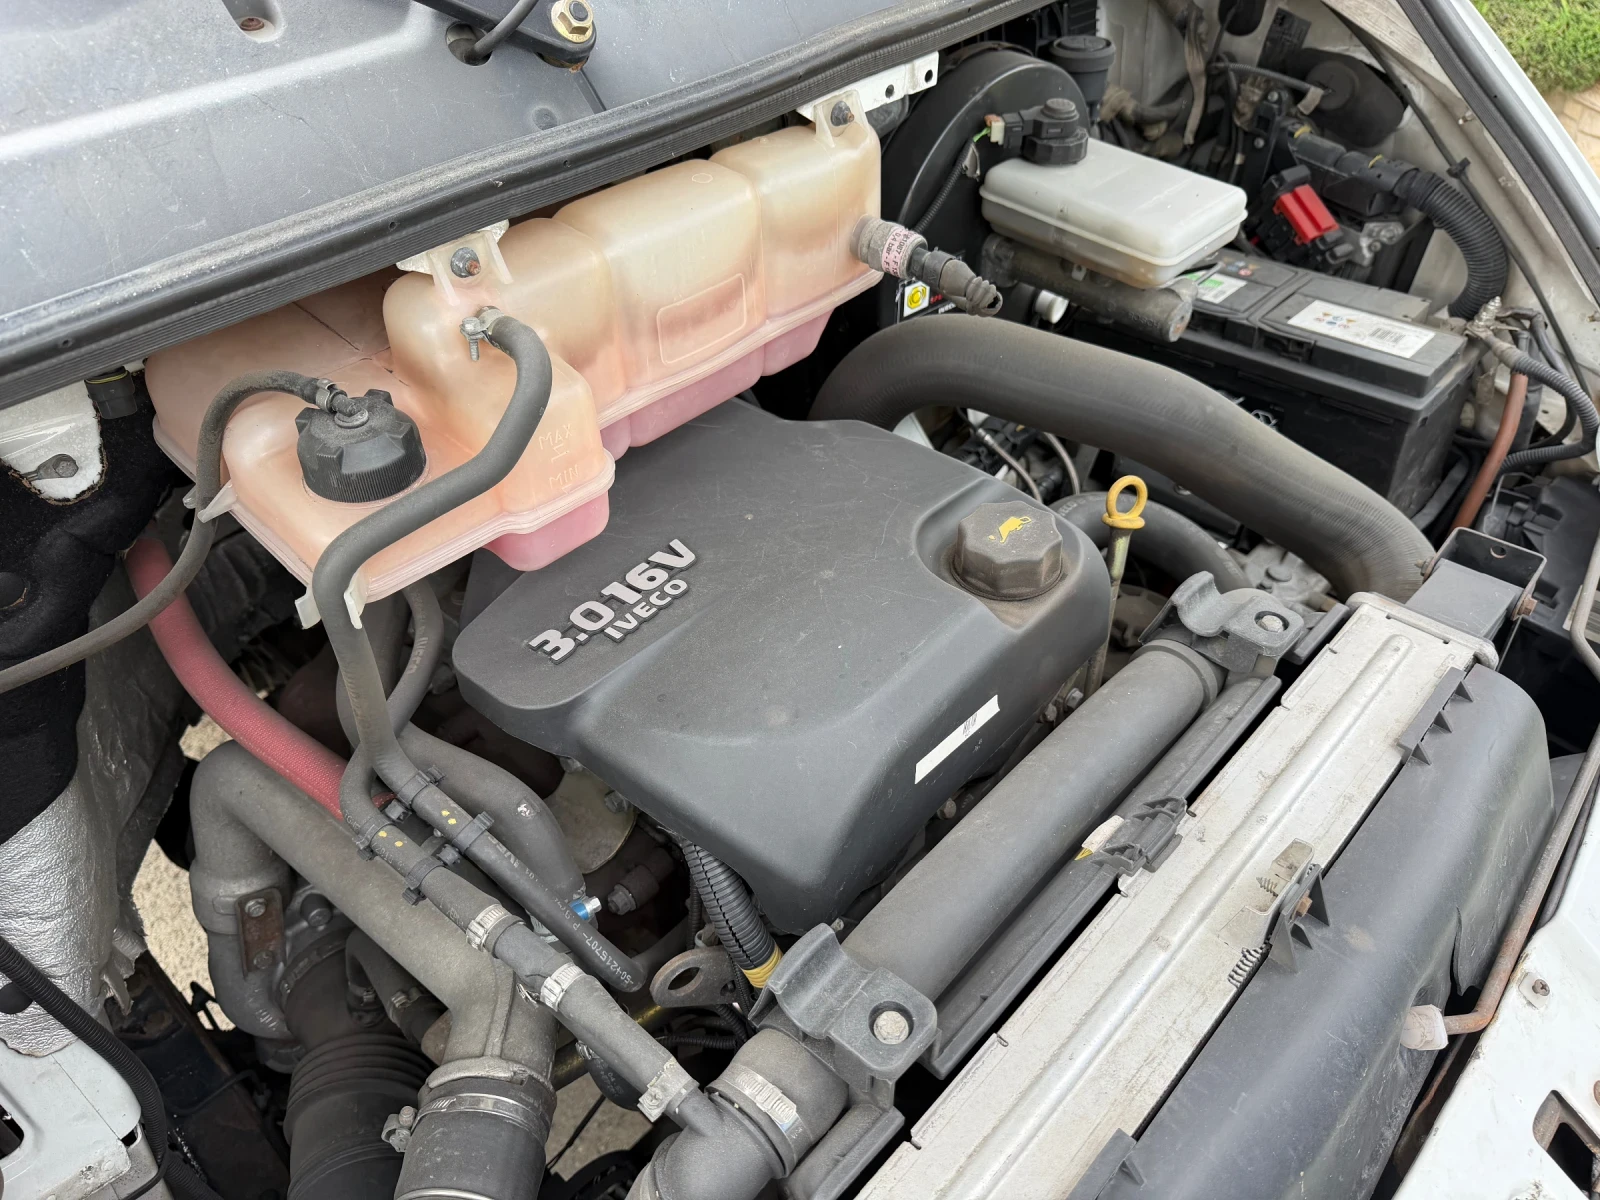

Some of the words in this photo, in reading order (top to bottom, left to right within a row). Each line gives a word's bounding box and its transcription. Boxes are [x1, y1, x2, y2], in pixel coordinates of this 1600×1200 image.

[539, 424, 572, 450] MAX
[549, 464, 578, 489] MIN
[603, 578, 689, 643] IVECO
